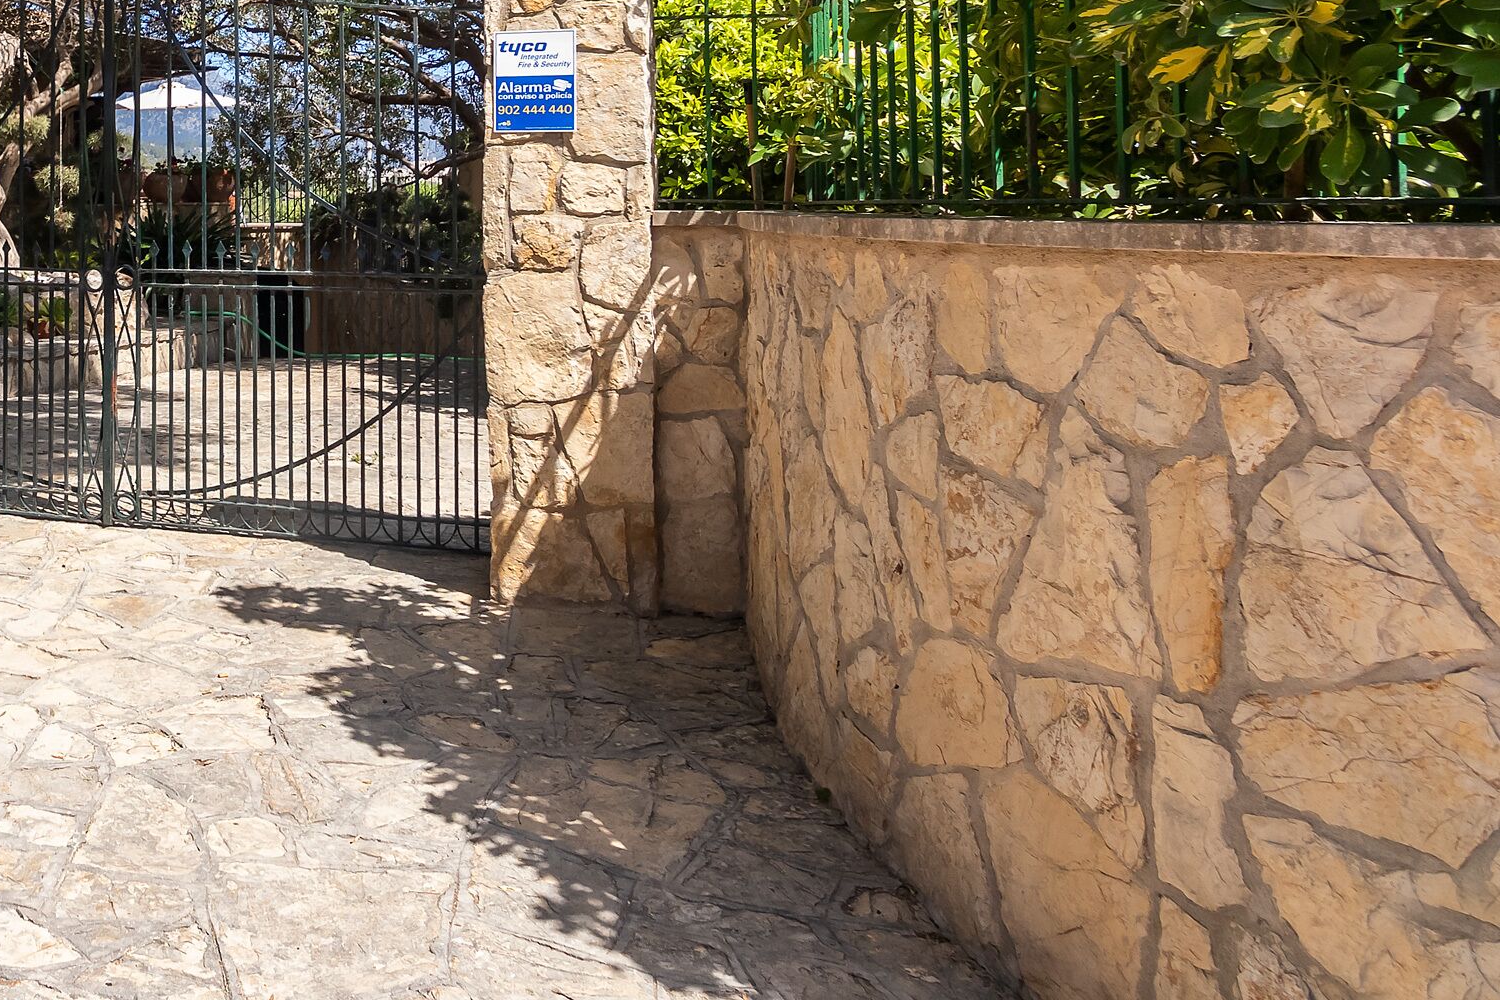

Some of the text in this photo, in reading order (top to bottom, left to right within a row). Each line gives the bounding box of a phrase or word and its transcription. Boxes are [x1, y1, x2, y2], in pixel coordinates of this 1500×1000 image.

[498, 41, 547, 56] tyco
[520, 53, 559, 61] Integrated
[541, 60, 571, 68] Security
[498, 81, 552, 93] Alarma
[545, 92, 572, 100] policía
[498, 104, 572, 115] 902 444 440
